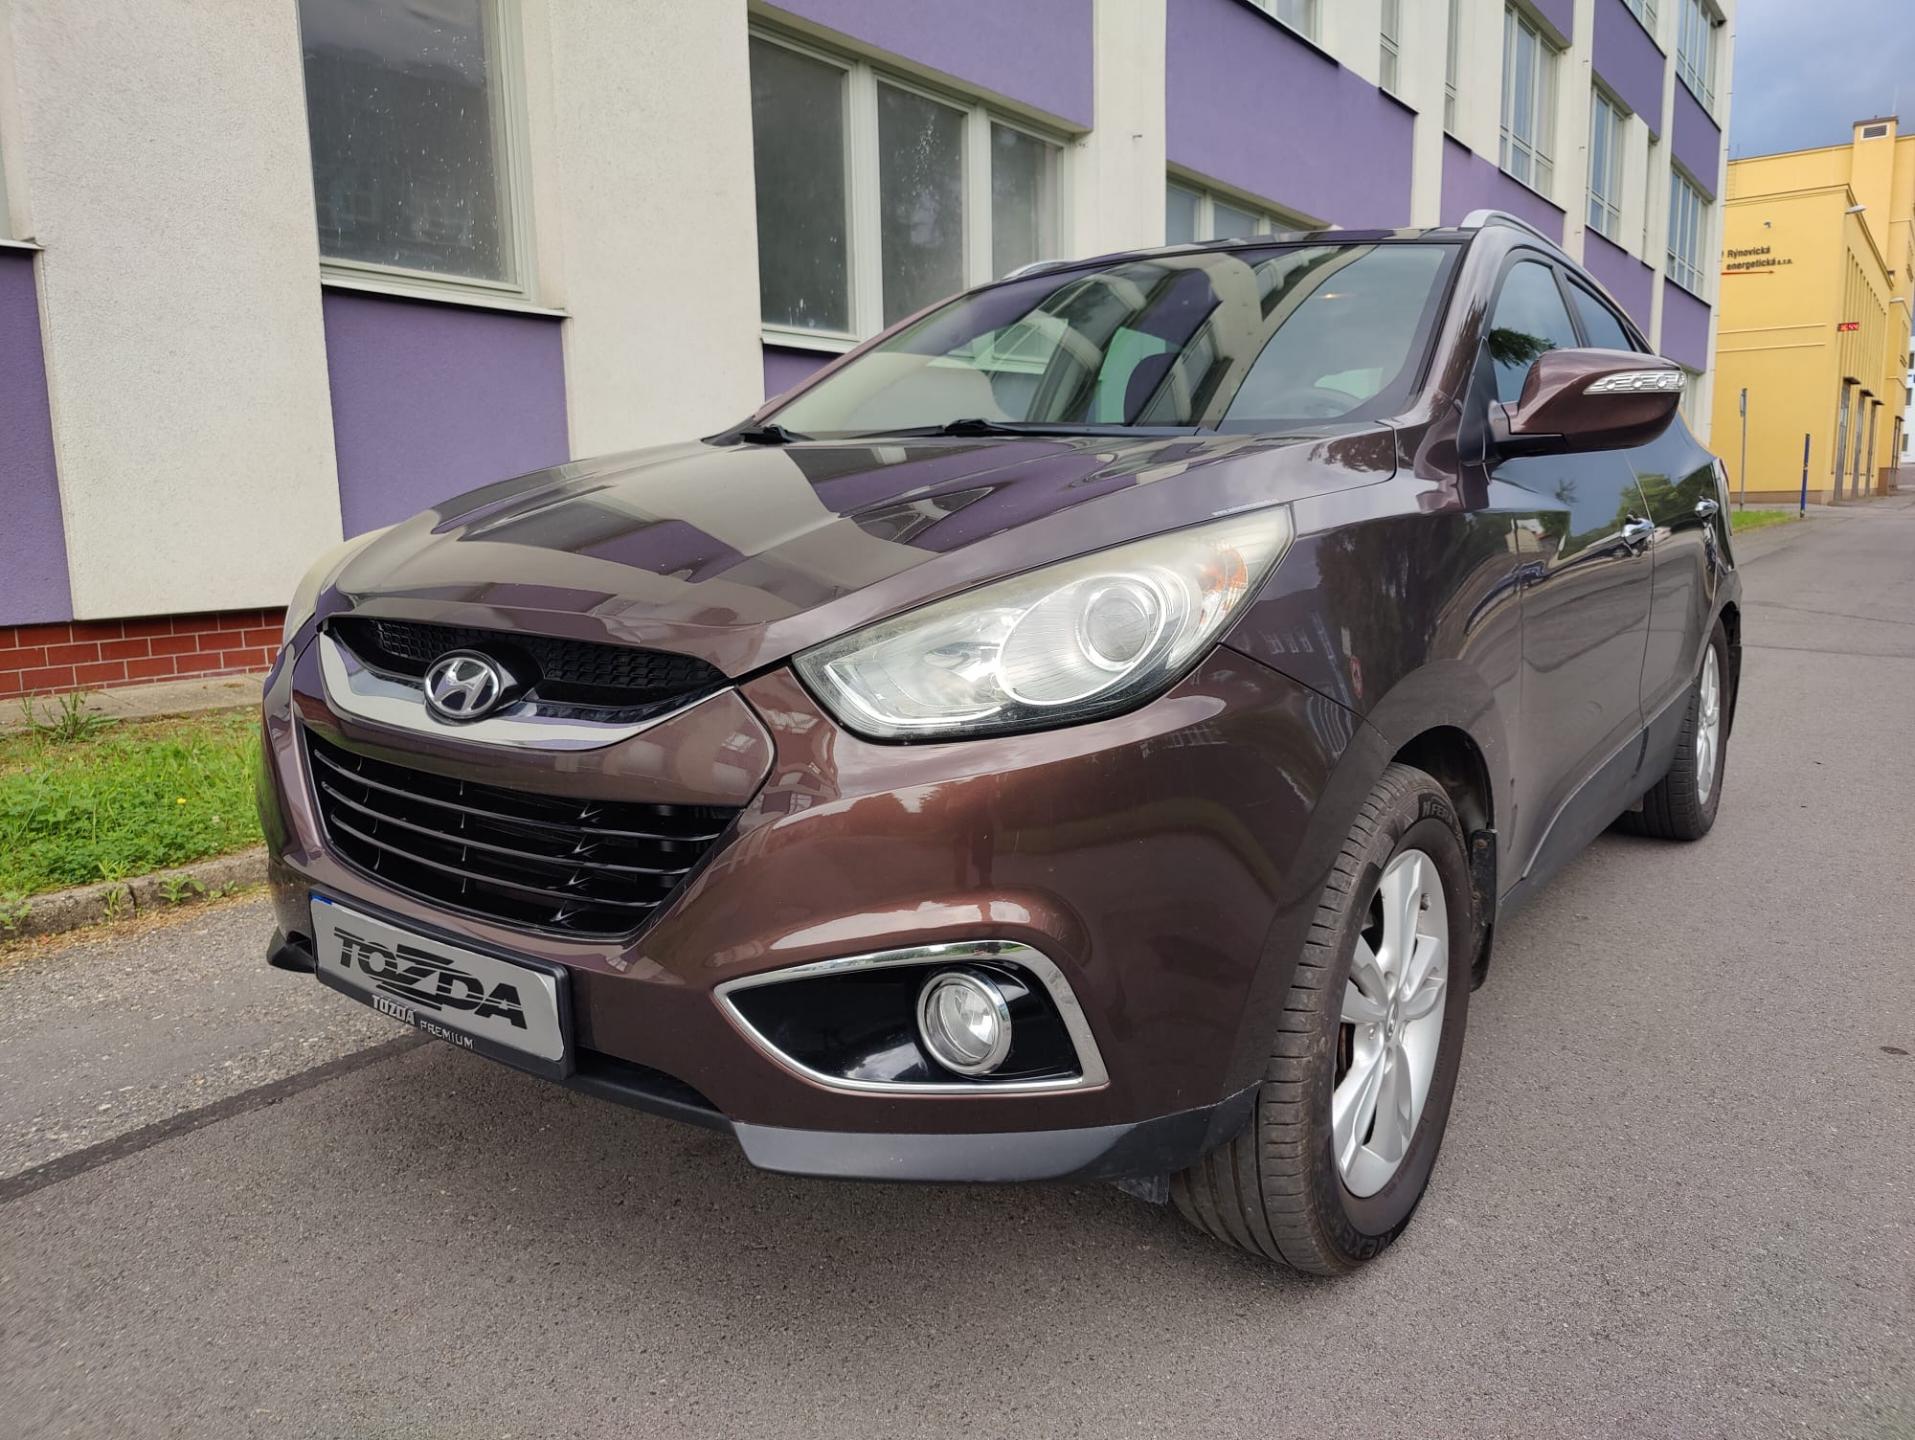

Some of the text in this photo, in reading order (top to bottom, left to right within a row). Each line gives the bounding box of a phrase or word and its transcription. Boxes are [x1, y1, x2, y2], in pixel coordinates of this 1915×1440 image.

[1726, 258, 1776, 270] energetická
[333, 927, 528, 1030] TOZDA
[371, 994, 475, 1051] TOZDA PREMIUM
